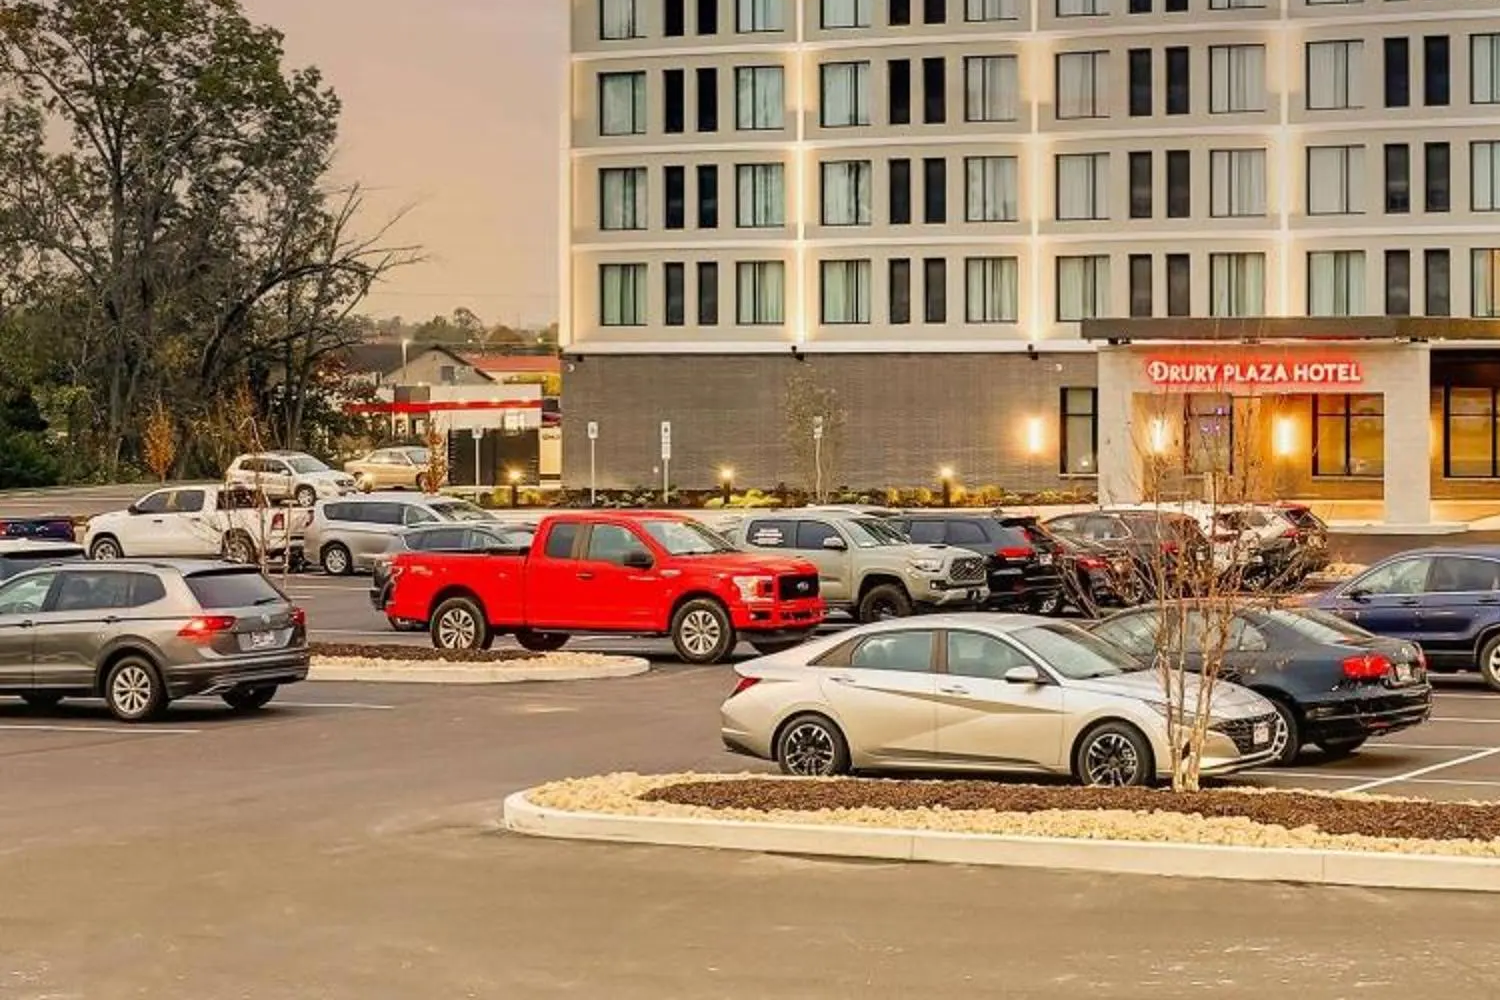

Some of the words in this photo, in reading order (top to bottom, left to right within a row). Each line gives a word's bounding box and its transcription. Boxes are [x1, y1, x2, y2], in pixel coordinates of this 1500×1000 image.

[1148, 360, 1217, 383] DRURY
[1223, 363, 1289, 382] PLAZA
[1294, 362, 1361, 382] HOTEL
